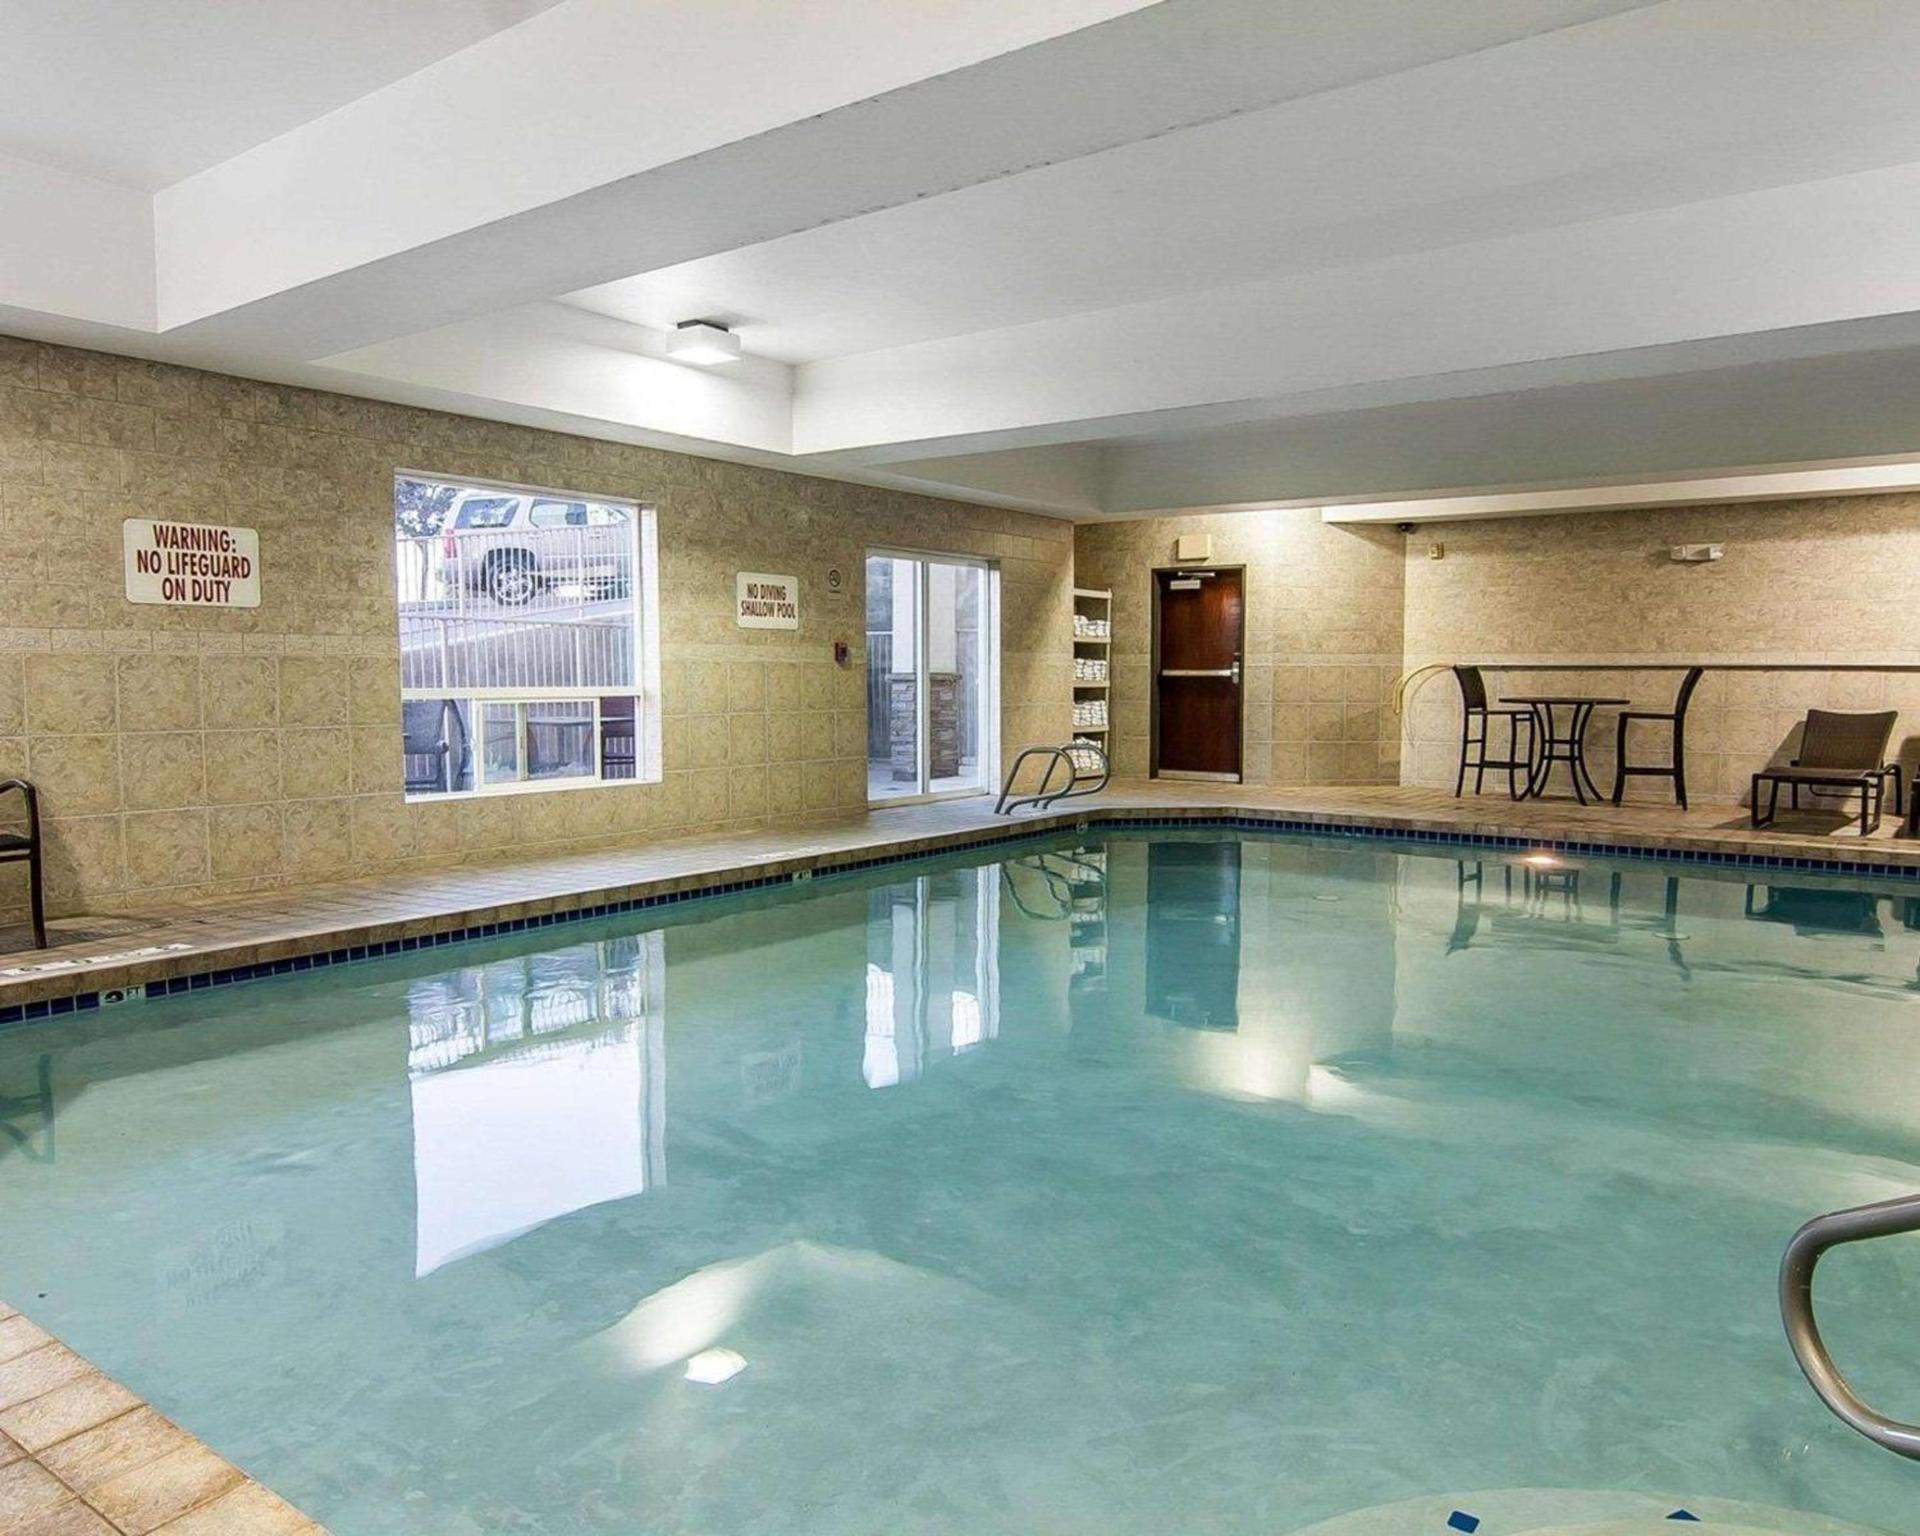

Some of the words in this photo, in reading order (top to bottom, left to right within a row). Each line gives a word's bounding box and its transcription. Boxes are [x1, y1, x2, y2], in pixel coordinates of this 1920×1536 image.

[153, 524, 237, 553] WARNING:
[137, 549, 162, 574] NO
[167, 551, 251, 579] LIFEGUARD
[162, 577, 186, 601] ON
[192, 579, 231, 603] DUTY
[747, 583, 759, 599] NO
[760, 584, 787, 601] DIVING
[741, 600, 775, 617] SHALLOW
[777, 602, 796, 619] POOL
